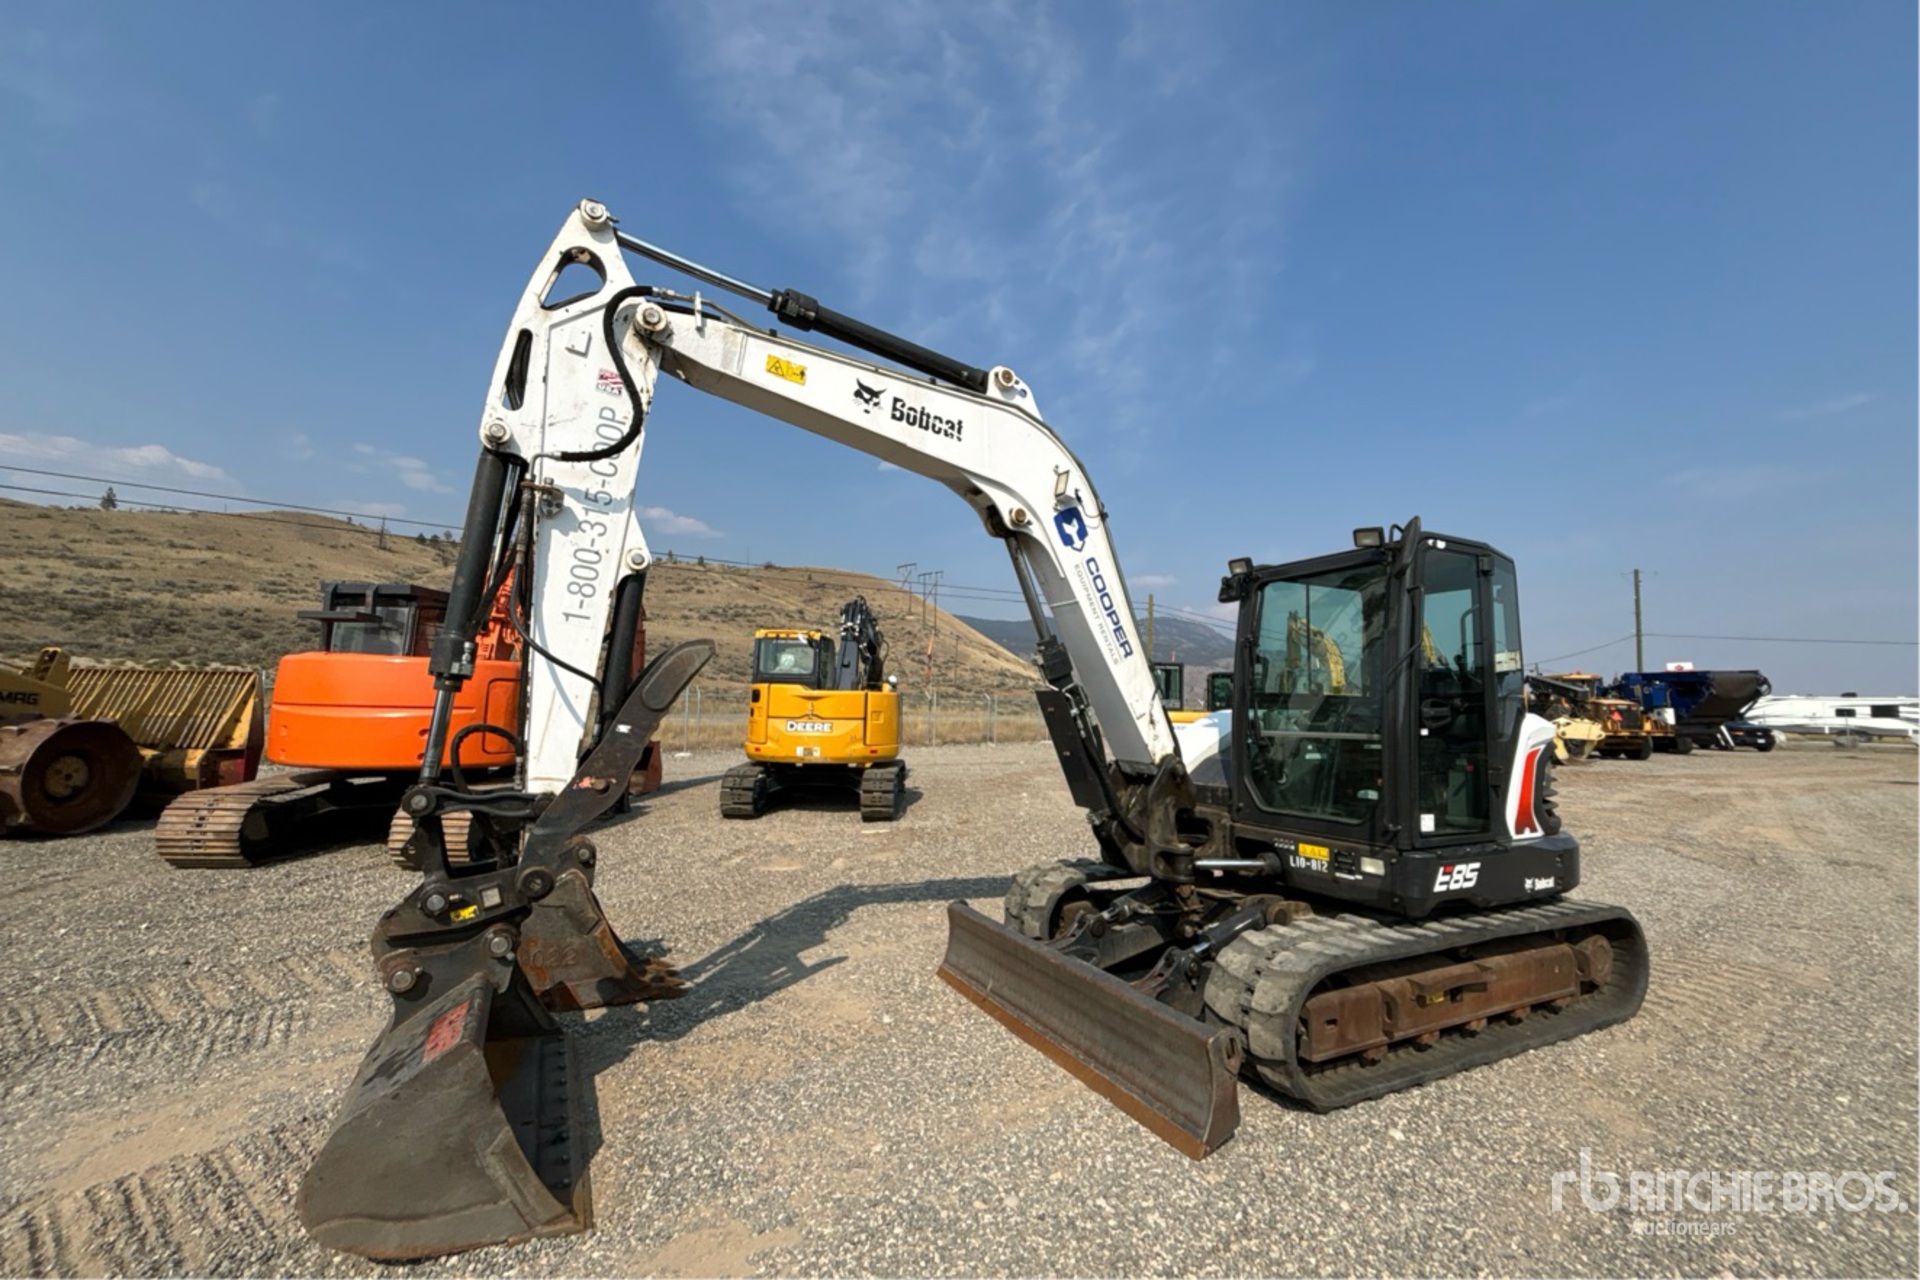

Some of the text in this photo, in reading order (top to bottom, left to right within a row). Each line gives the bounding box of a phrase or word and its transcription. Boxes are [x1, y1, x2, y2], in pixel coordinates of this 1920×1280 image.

[890, 396, 964, 442] Bobcat
[1074, 563, 1119, 665] EQUIPMENT RENTALS
[1085, 556, 1134, 659] COOPER
[786, 721, 833, 732] DEERE
[1433, 862, 1481, 892] E85
